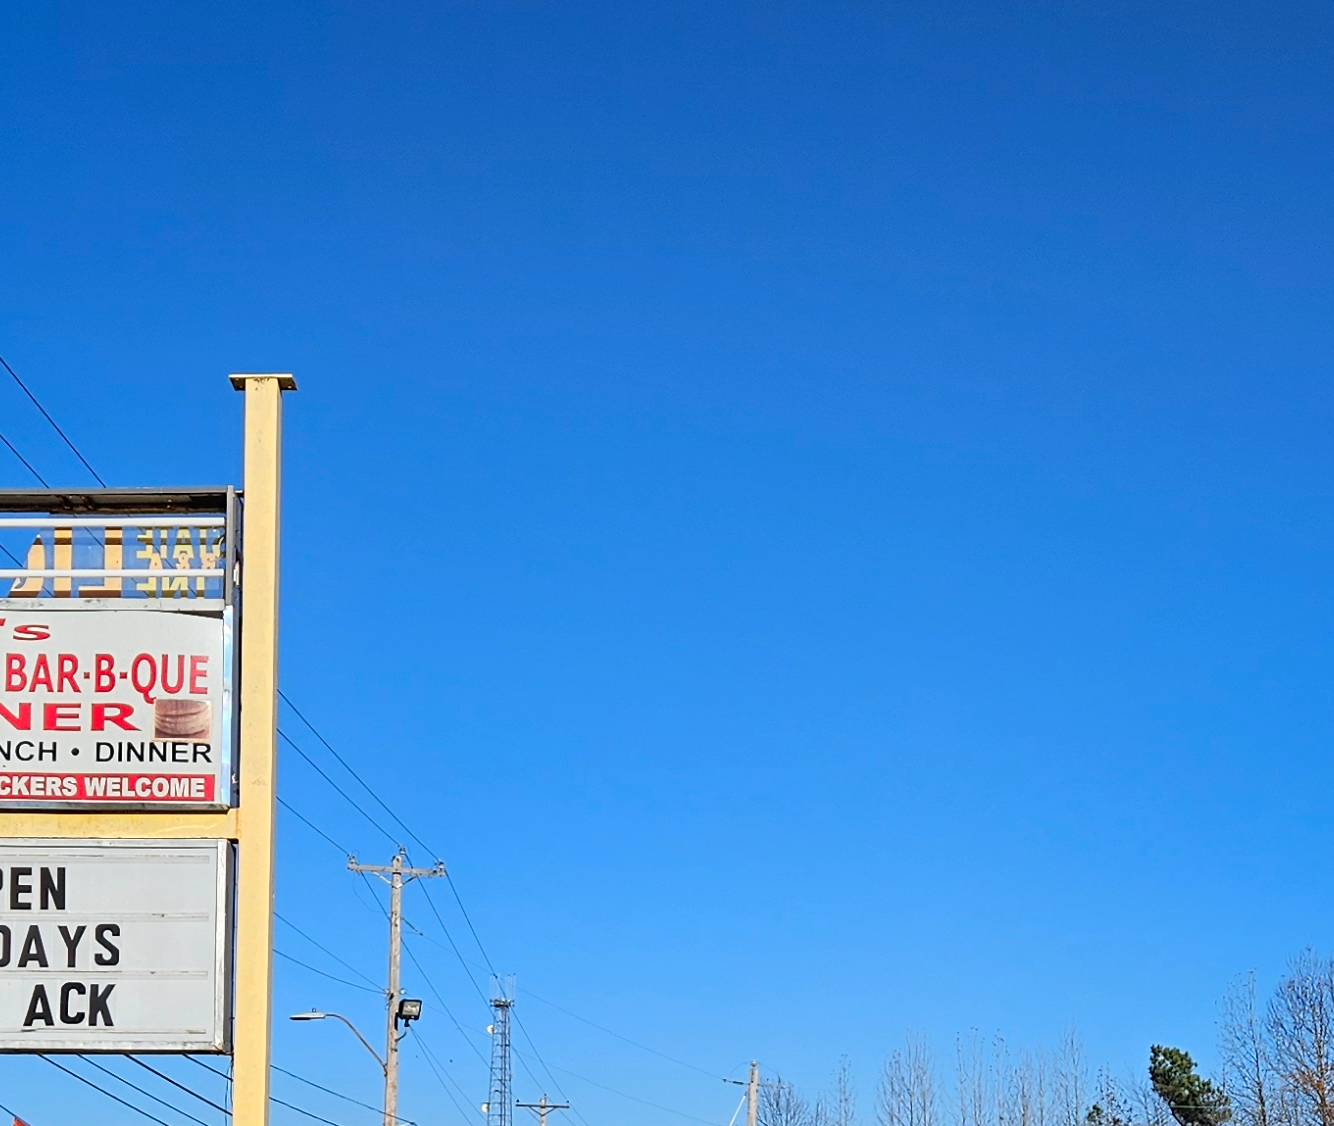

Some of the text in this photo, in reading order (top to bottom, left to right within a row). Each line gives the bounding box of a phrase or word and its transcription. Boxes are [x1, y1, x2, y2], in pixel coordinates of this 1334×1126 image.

[95, 742, 212, 763] DINNER
[84, 777, 205, 797] WELCOME
[23, 982, 115, 1027] ACK
